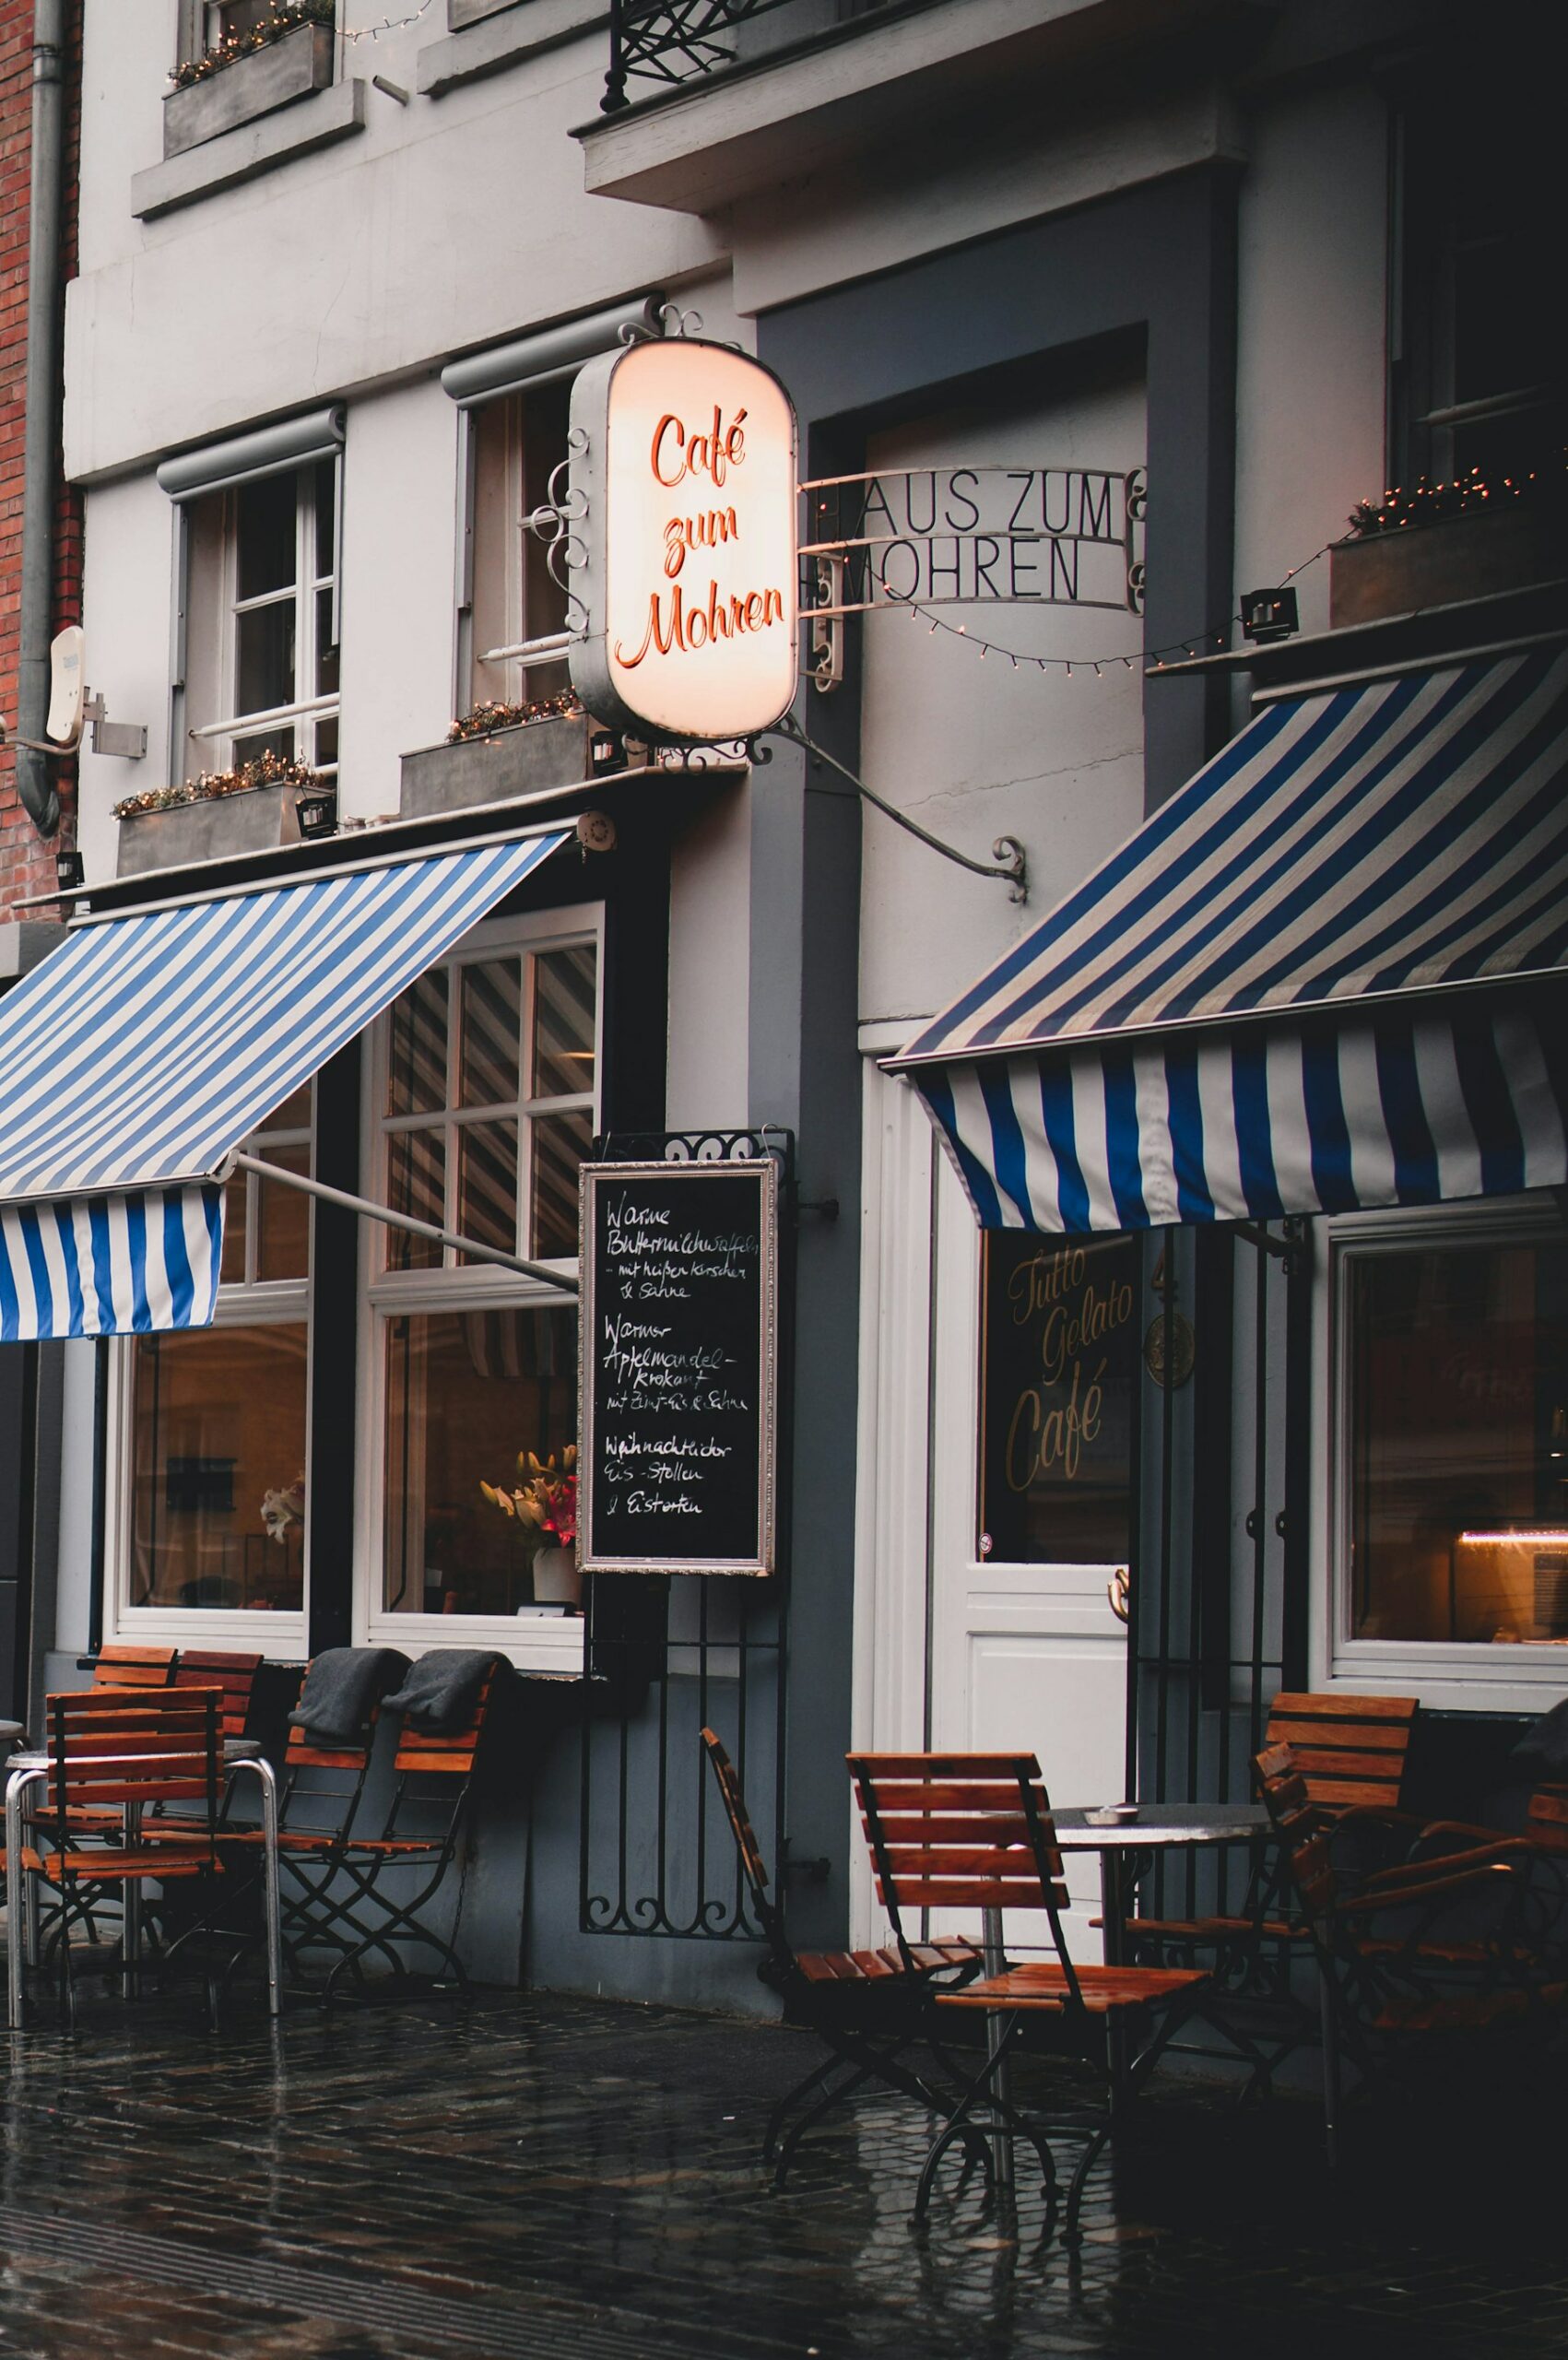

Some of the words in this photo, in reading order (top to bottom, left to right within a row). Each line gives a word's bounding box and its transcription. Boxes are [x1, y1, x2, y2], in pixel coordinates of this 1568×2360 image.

[651, 404, 749, 488] Café
[1007, 469, 1112, 537] ZUM
[664, 504, 739, 578] zum
[842, 536, 1078, 605] MOHREN
[615, 579, 785, 669] Mohren
[607, 1190, 671, 1228] Warme
[619, 1260, 642, 1280] mit
[620, 1280, 633, 1299] &
[639, 1281, 691, 1299] Sahne
[1008, 1245, 1086, 1326] Tutto
[605, 1313, 672, 1343] Warmer
[1043, 1280, 1133, 1386] Gelato
[607, 1390, 629, 1414] mit
[1006, 1357, 1107, 1492] Café
[627, 1491, 703, 1514] Eistorten
